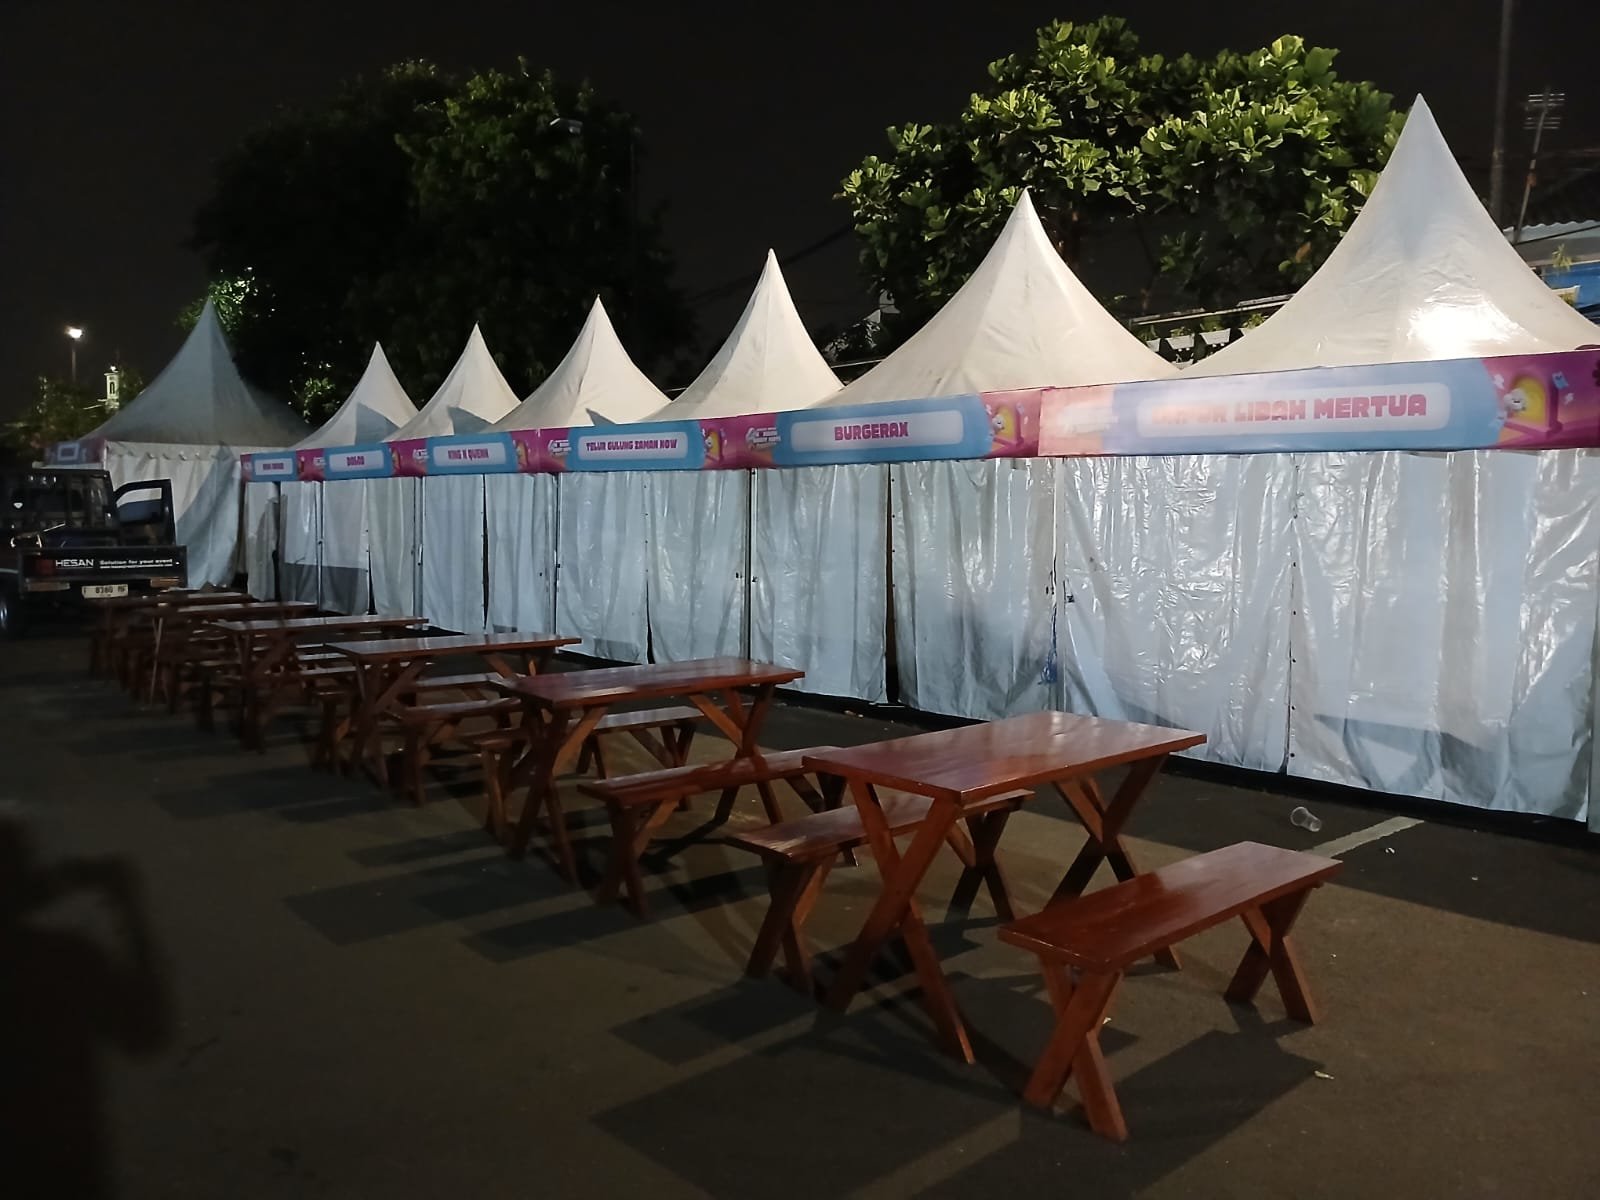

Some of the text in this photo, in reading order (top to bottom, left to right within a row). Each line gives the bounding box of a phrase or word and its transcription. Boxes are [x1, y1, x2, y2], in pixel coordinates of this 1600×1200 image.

[1313, 393, 1428, 420] MERTUA
[586, 439, 678, 451] TELUR GULUNG ZAMAN NOW
[55, 559, 94, 567] HESAN
